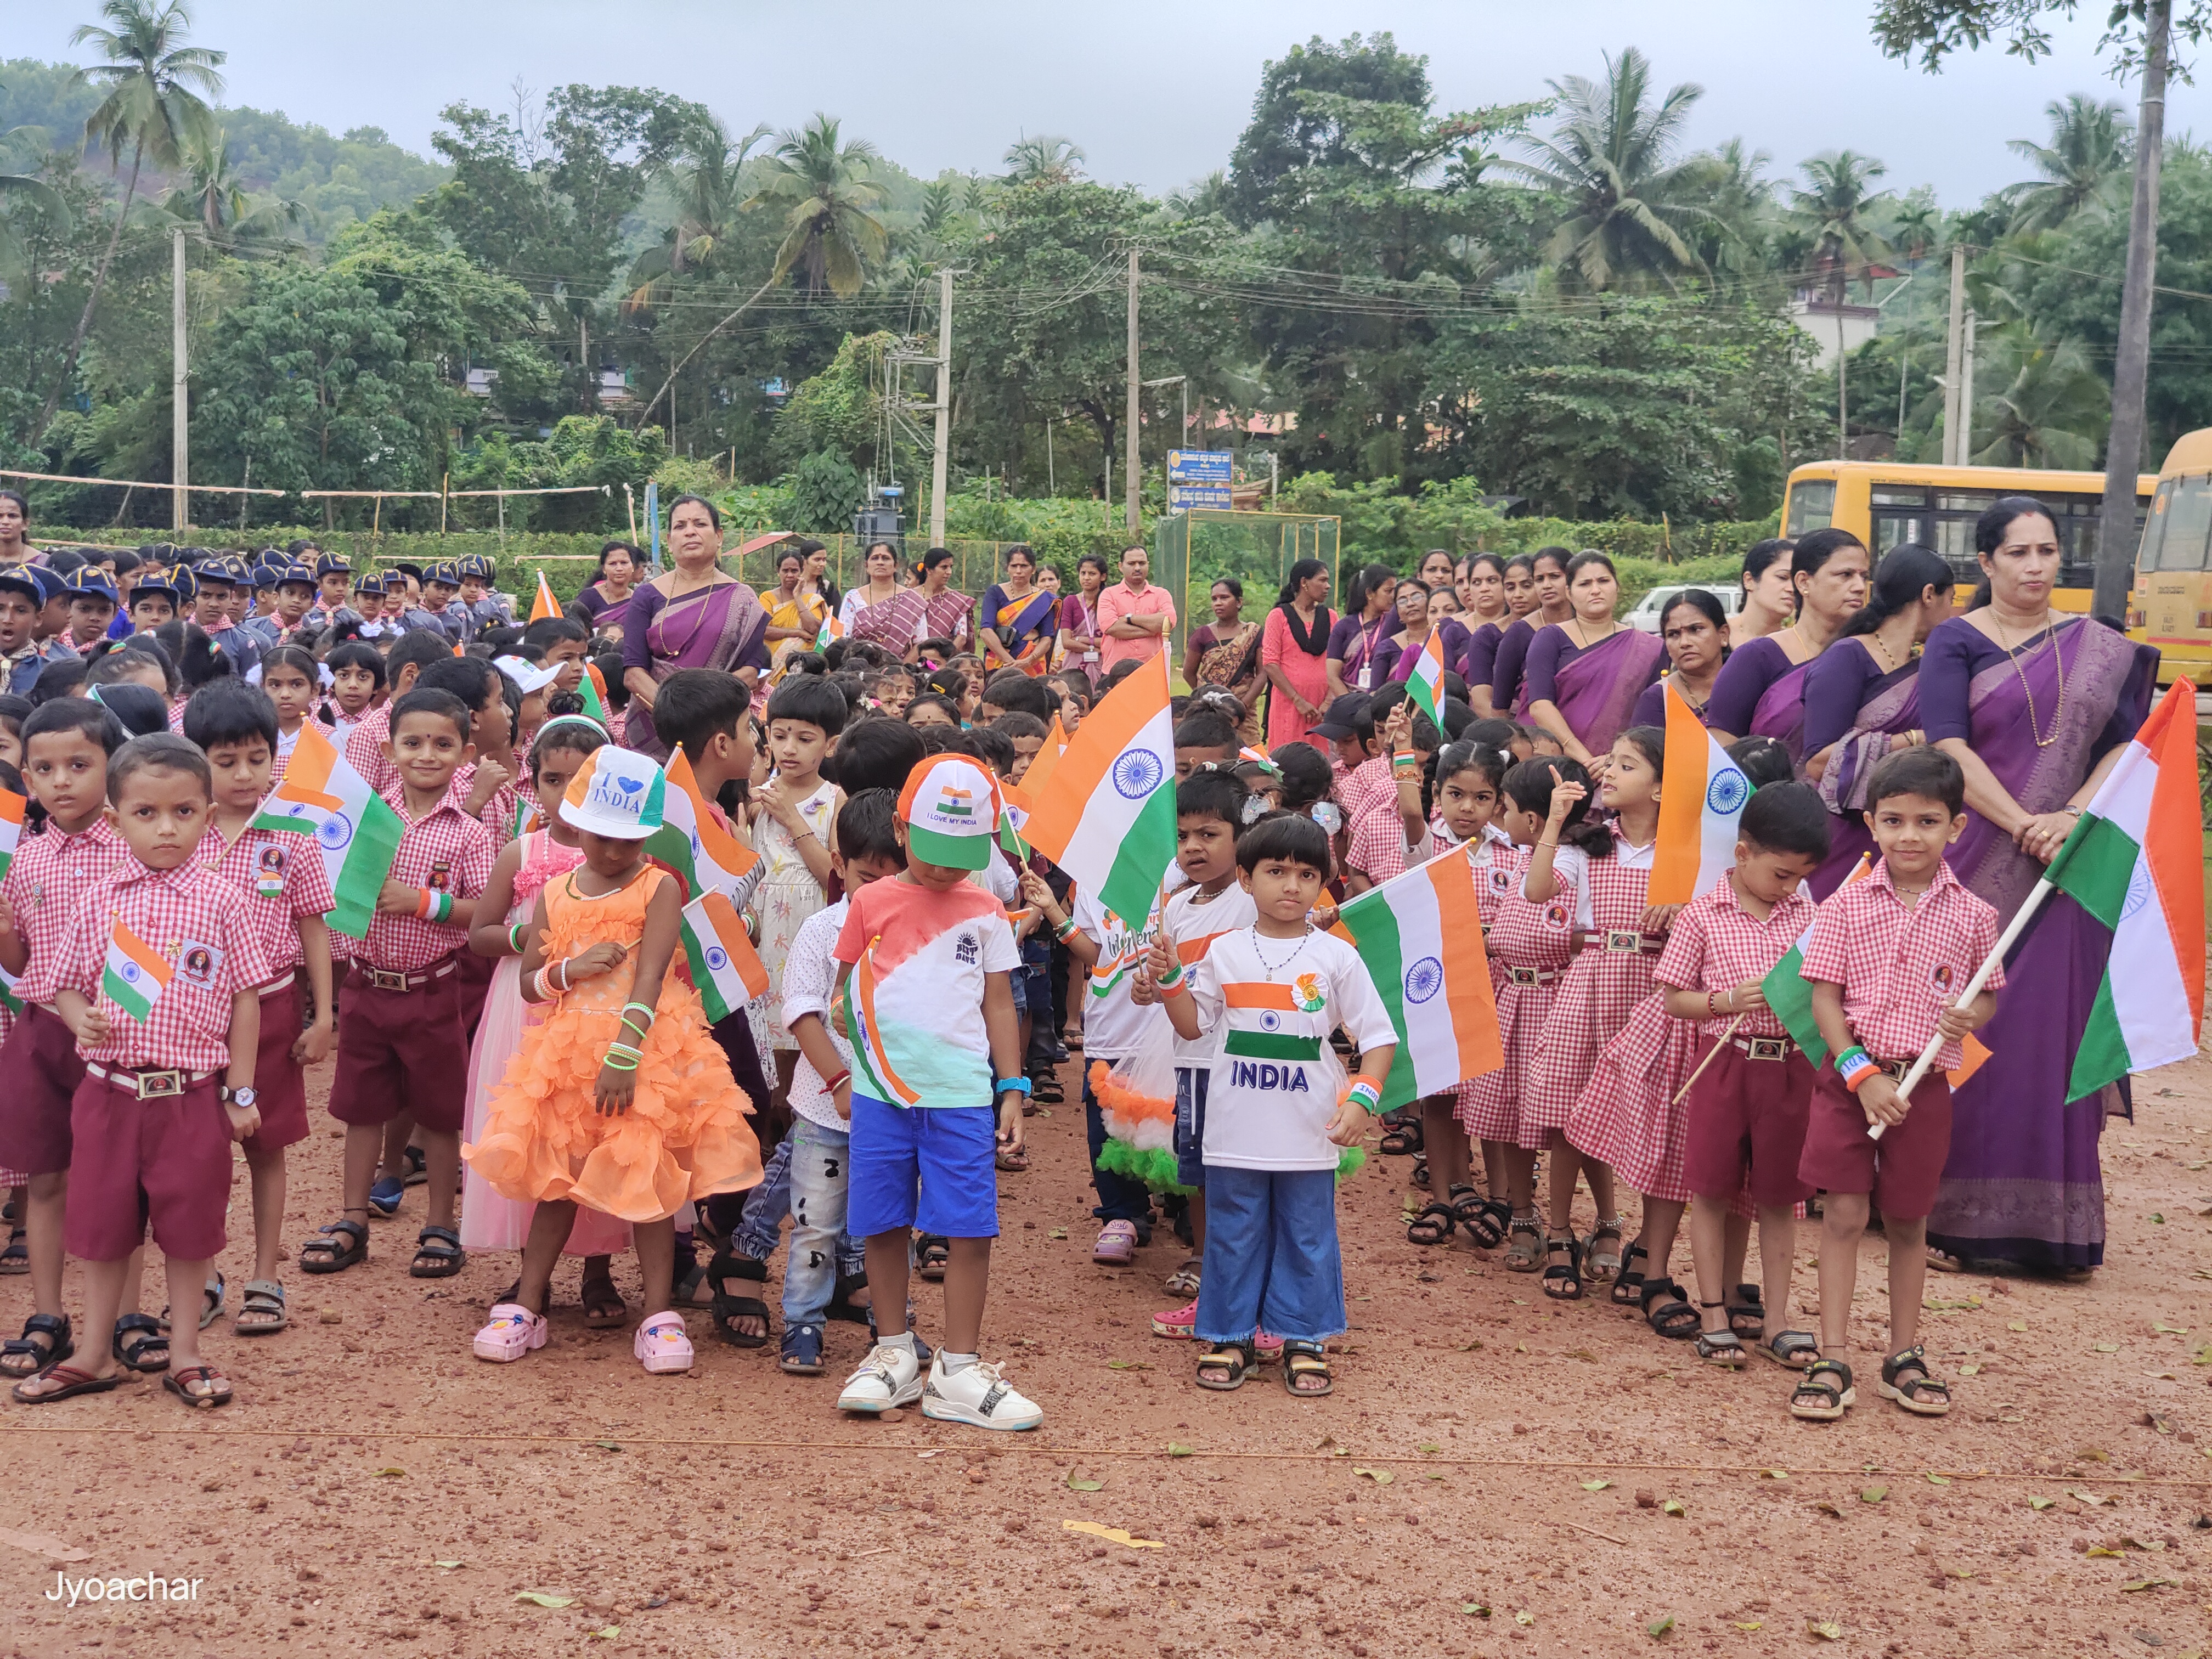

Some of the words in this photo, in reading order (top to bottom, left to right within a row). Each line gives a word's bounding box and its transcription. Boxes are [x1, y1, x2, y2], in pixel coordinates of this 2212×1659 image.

[601, 772, 612, 788] I
[594, 788, 640, 814] INDIA
[930, 813, 948, 823] LOVE
[956, 944, 978, 957] BEST
[1230, 1060, 1309, 1092] INDIA
